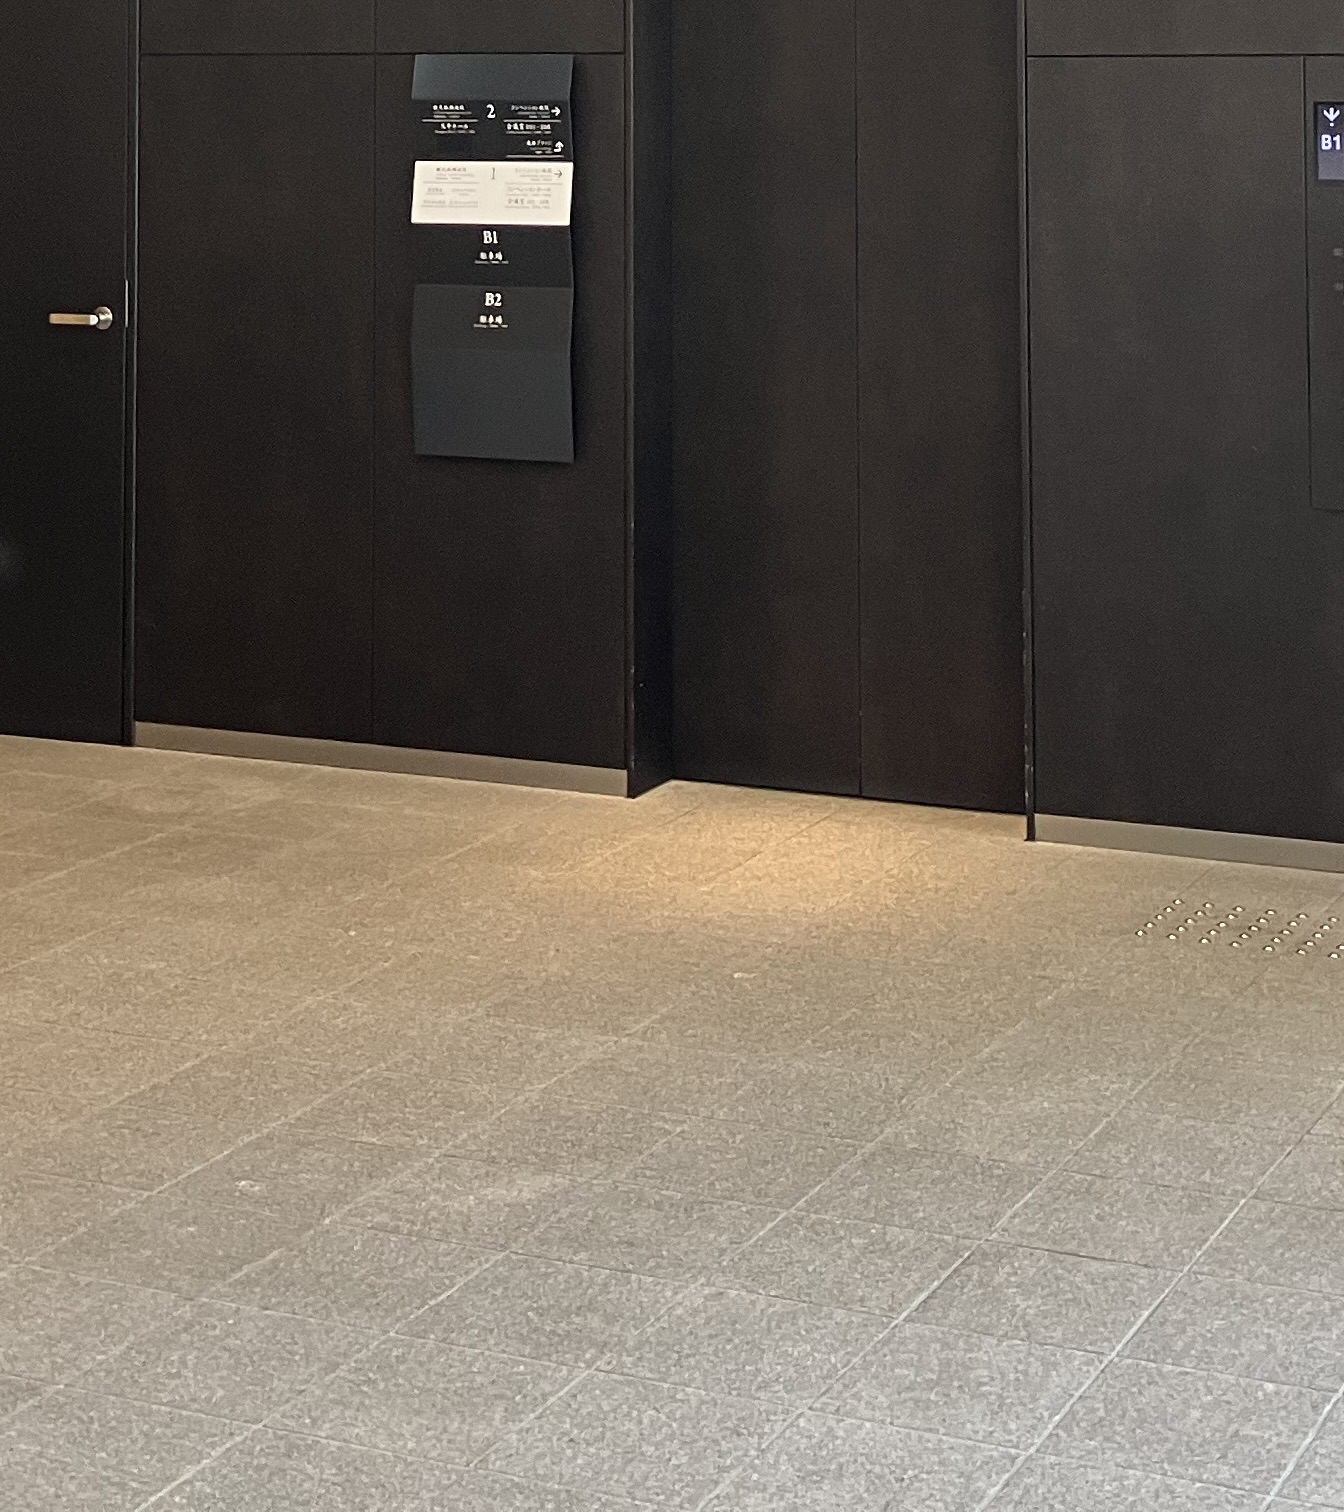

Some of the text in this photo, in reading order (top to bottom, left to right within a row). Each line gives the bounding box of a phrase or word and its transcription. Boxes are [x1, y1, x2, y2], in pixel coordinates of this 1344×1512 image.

[486, 103, 496, 119] 2
[1321, 134, 1341, 151] B1
[490, 167, 497, 180] 1
[483, 230, 499, 244] B1
[484, 292, 503, 307] B2
